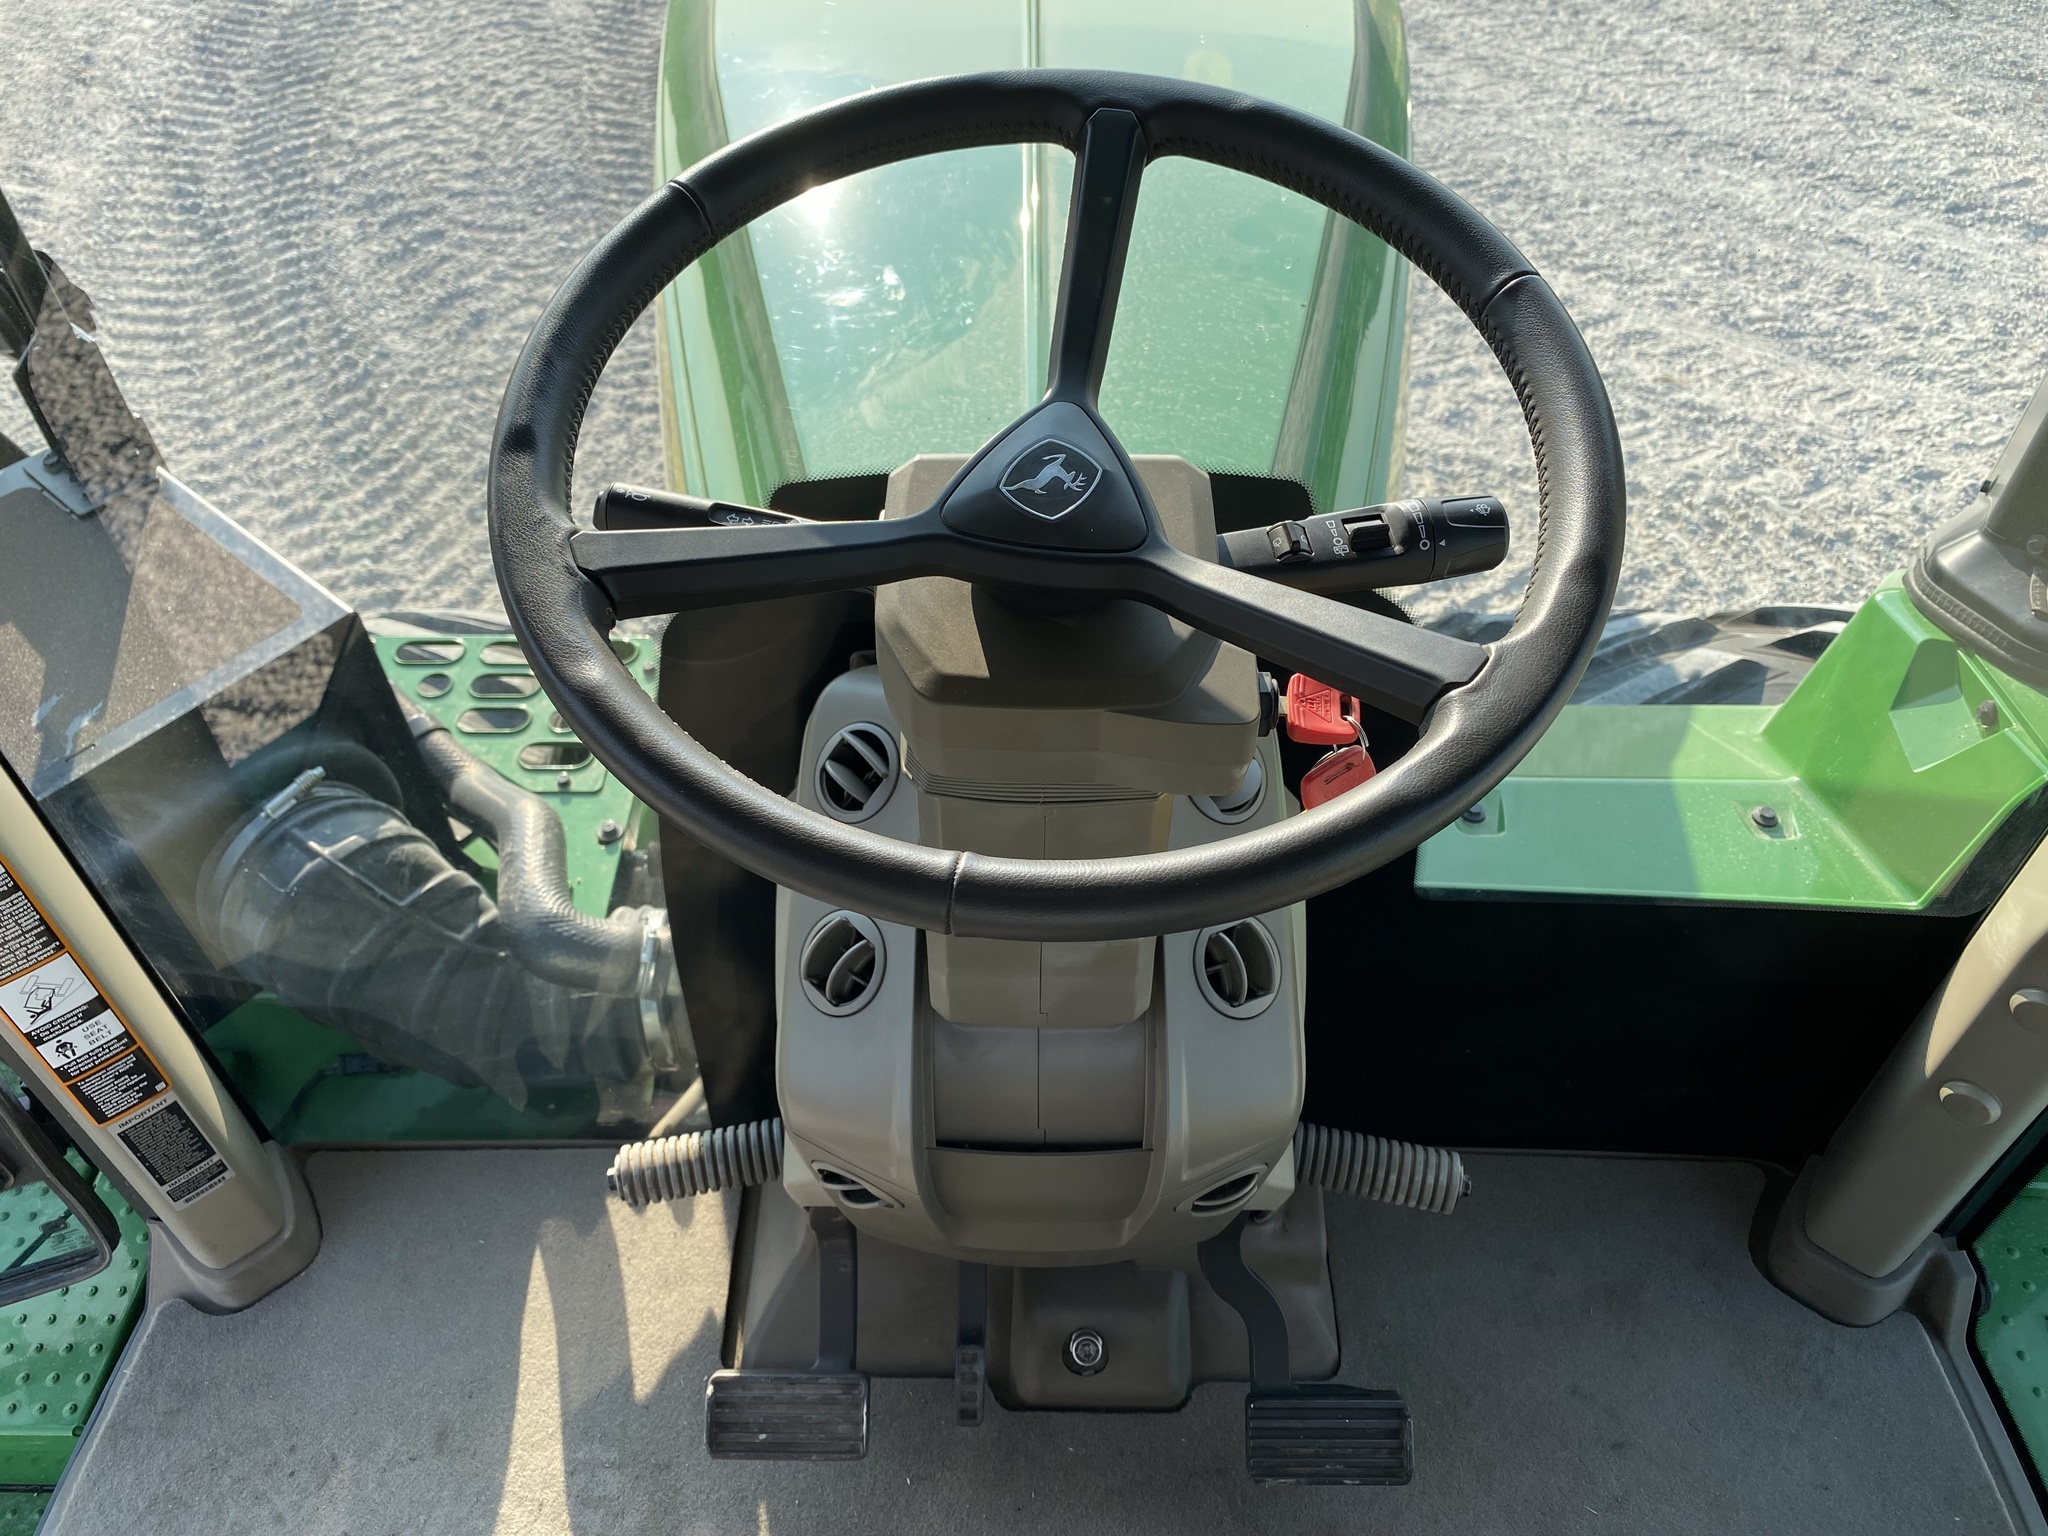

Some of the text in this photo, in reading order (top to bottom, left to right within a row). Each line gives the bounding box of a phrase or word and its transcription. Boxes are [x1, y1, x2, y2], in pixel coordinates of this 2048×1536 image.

[11, 902, 31, 916] towed
[0, 962, 18, 975] xceed
[31, 1004, 88, 1036] AVOID CRUSHING:
[49, 1024, 61, 1032] not
[60, 1016, 78, 1027] jump
[81, 1020, 101, 1033] USE
[43, 1019, 84, 1041] machine tips.
[83, 1024, 107, 1040] SEAT
[88, 1029, 112, 1046] BELT
[63, 1039, 118, 1069] Pull belt fully from
[67, 1037, 128, 1072] retractors and adjust
[80, 1062, 94, 1072] best
[118, 1098, 169, 1129] IMPORTANT
[168, 1159, 215, 1189] IMPORTANT
